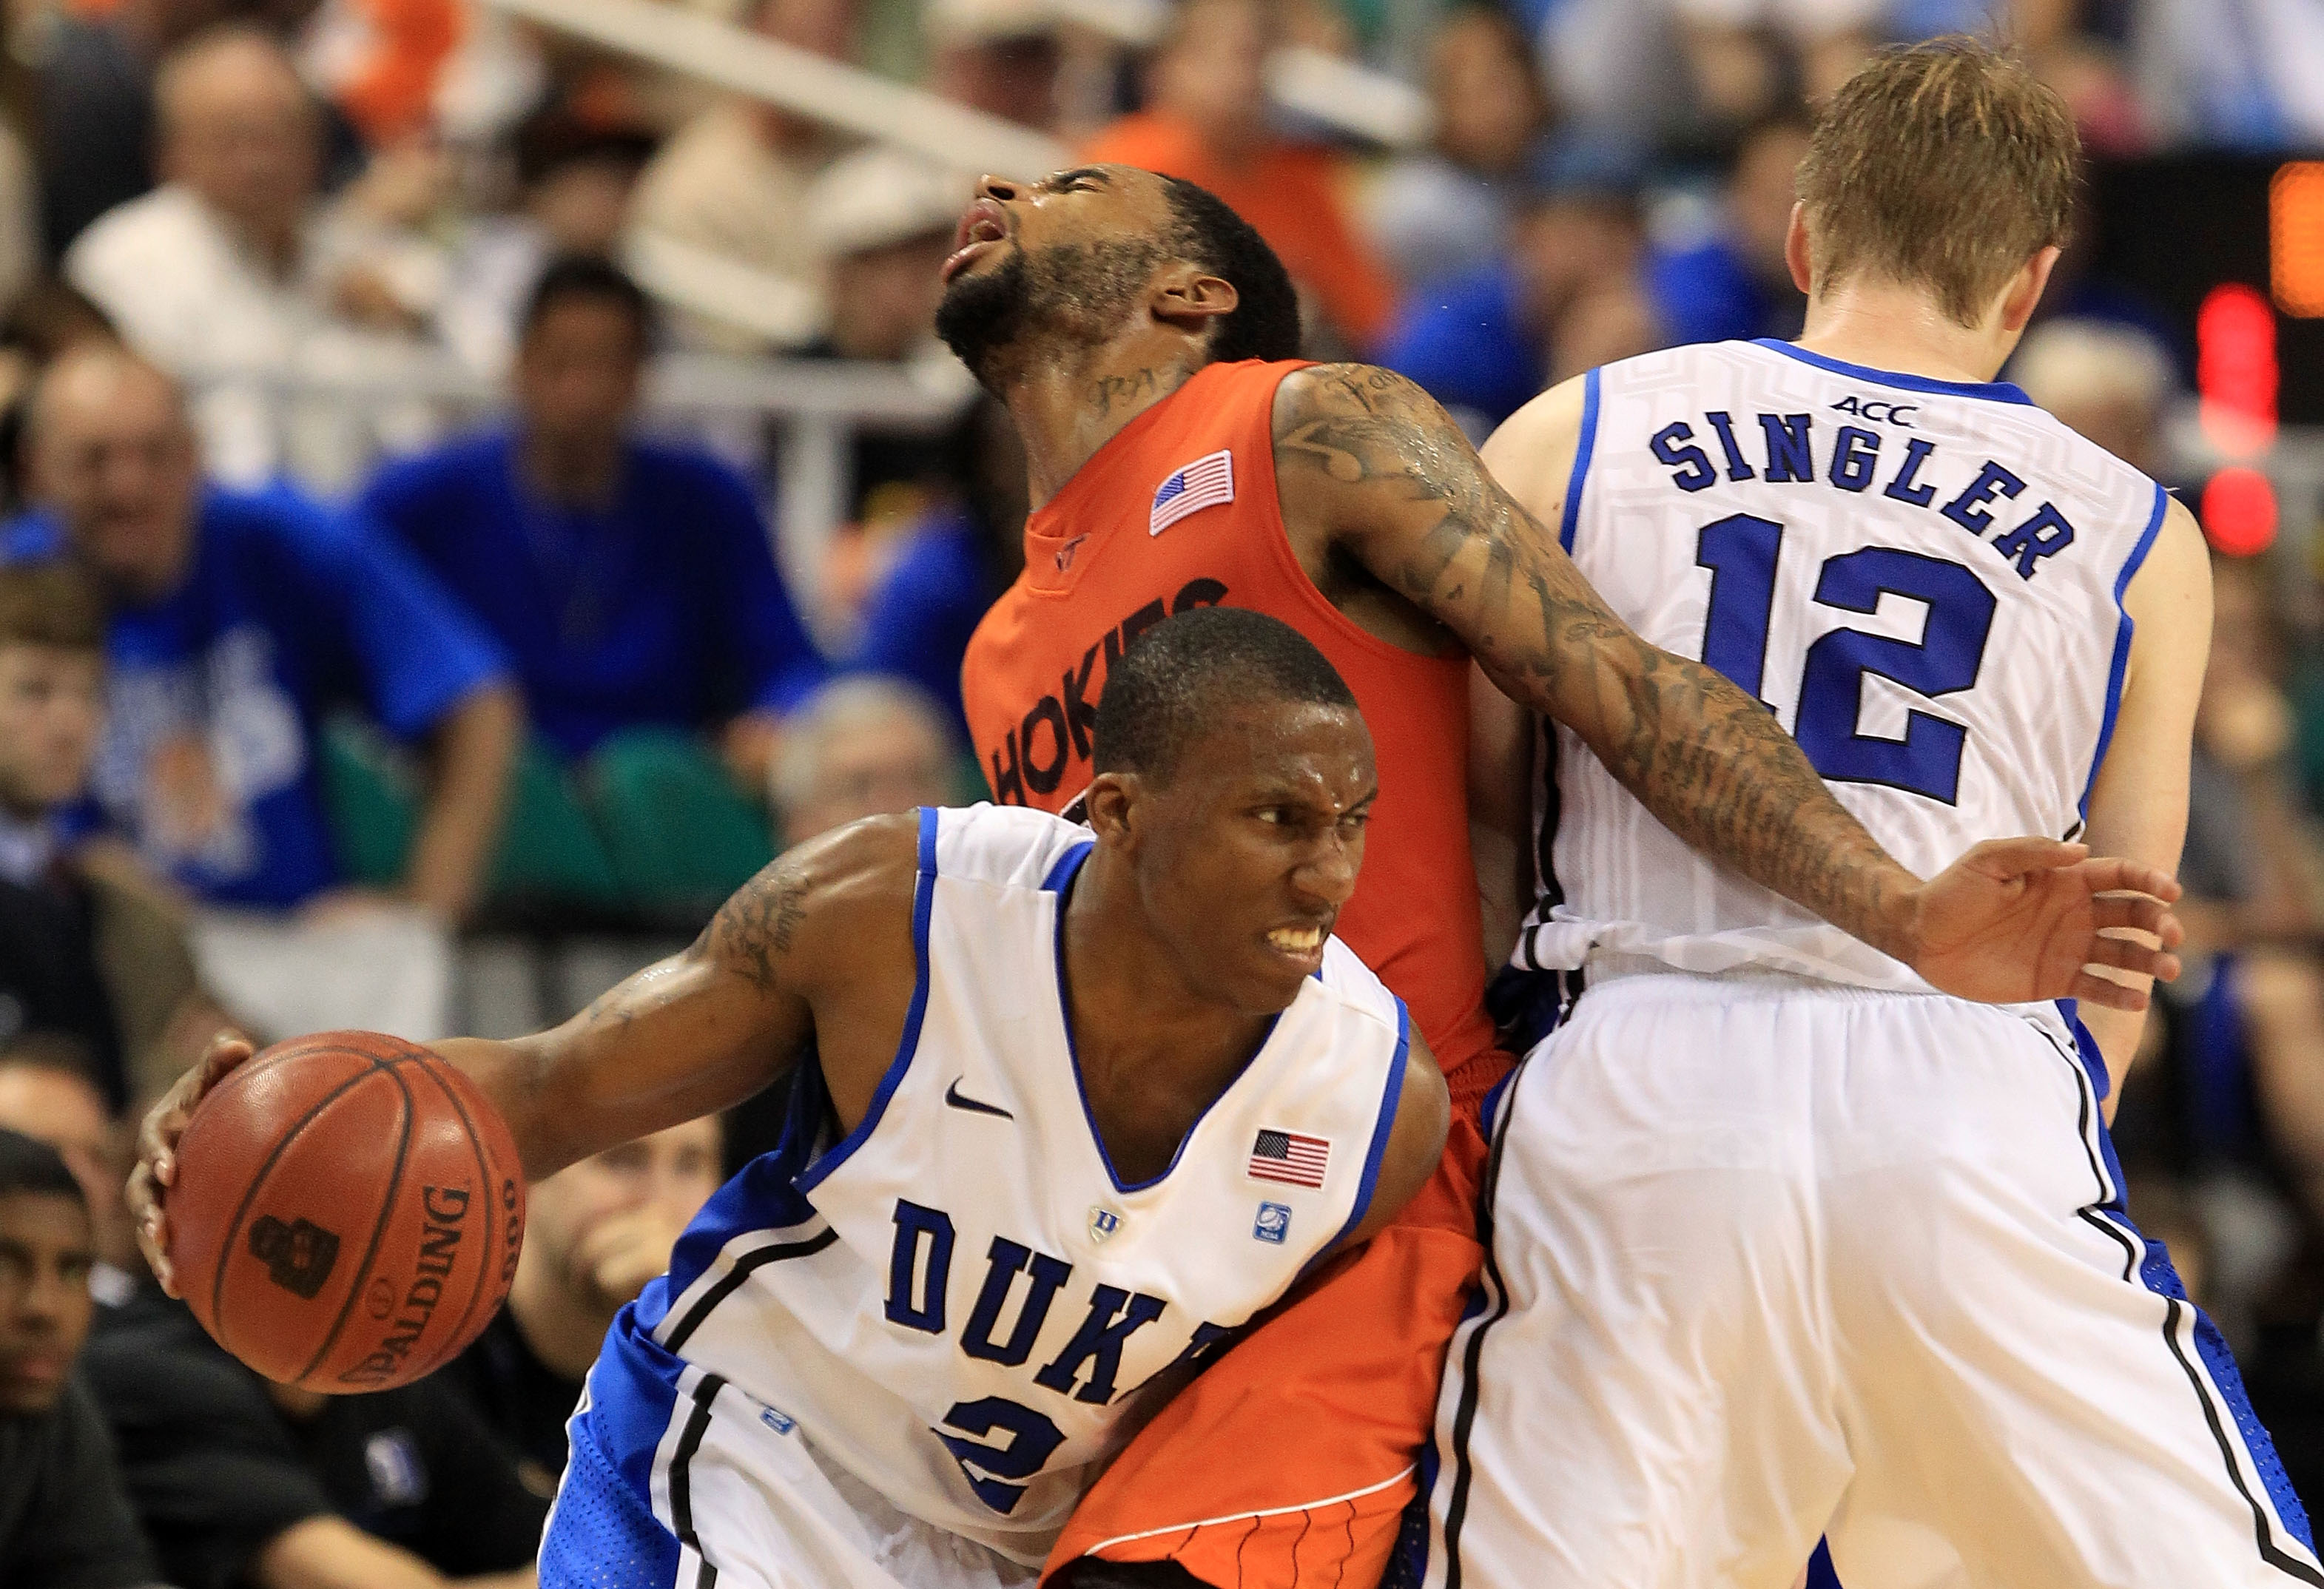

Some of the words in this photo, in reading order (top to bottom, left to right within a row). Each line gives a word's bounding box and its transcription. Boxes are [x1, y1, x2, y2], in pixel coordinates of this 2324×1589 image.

[1830, 395, 1919, 428] ACC
[1648, 411, 2075, 581] SINGLER
[1696, 512, 1998, 807] 12
[929, 1394, 1067, 1516] 2
